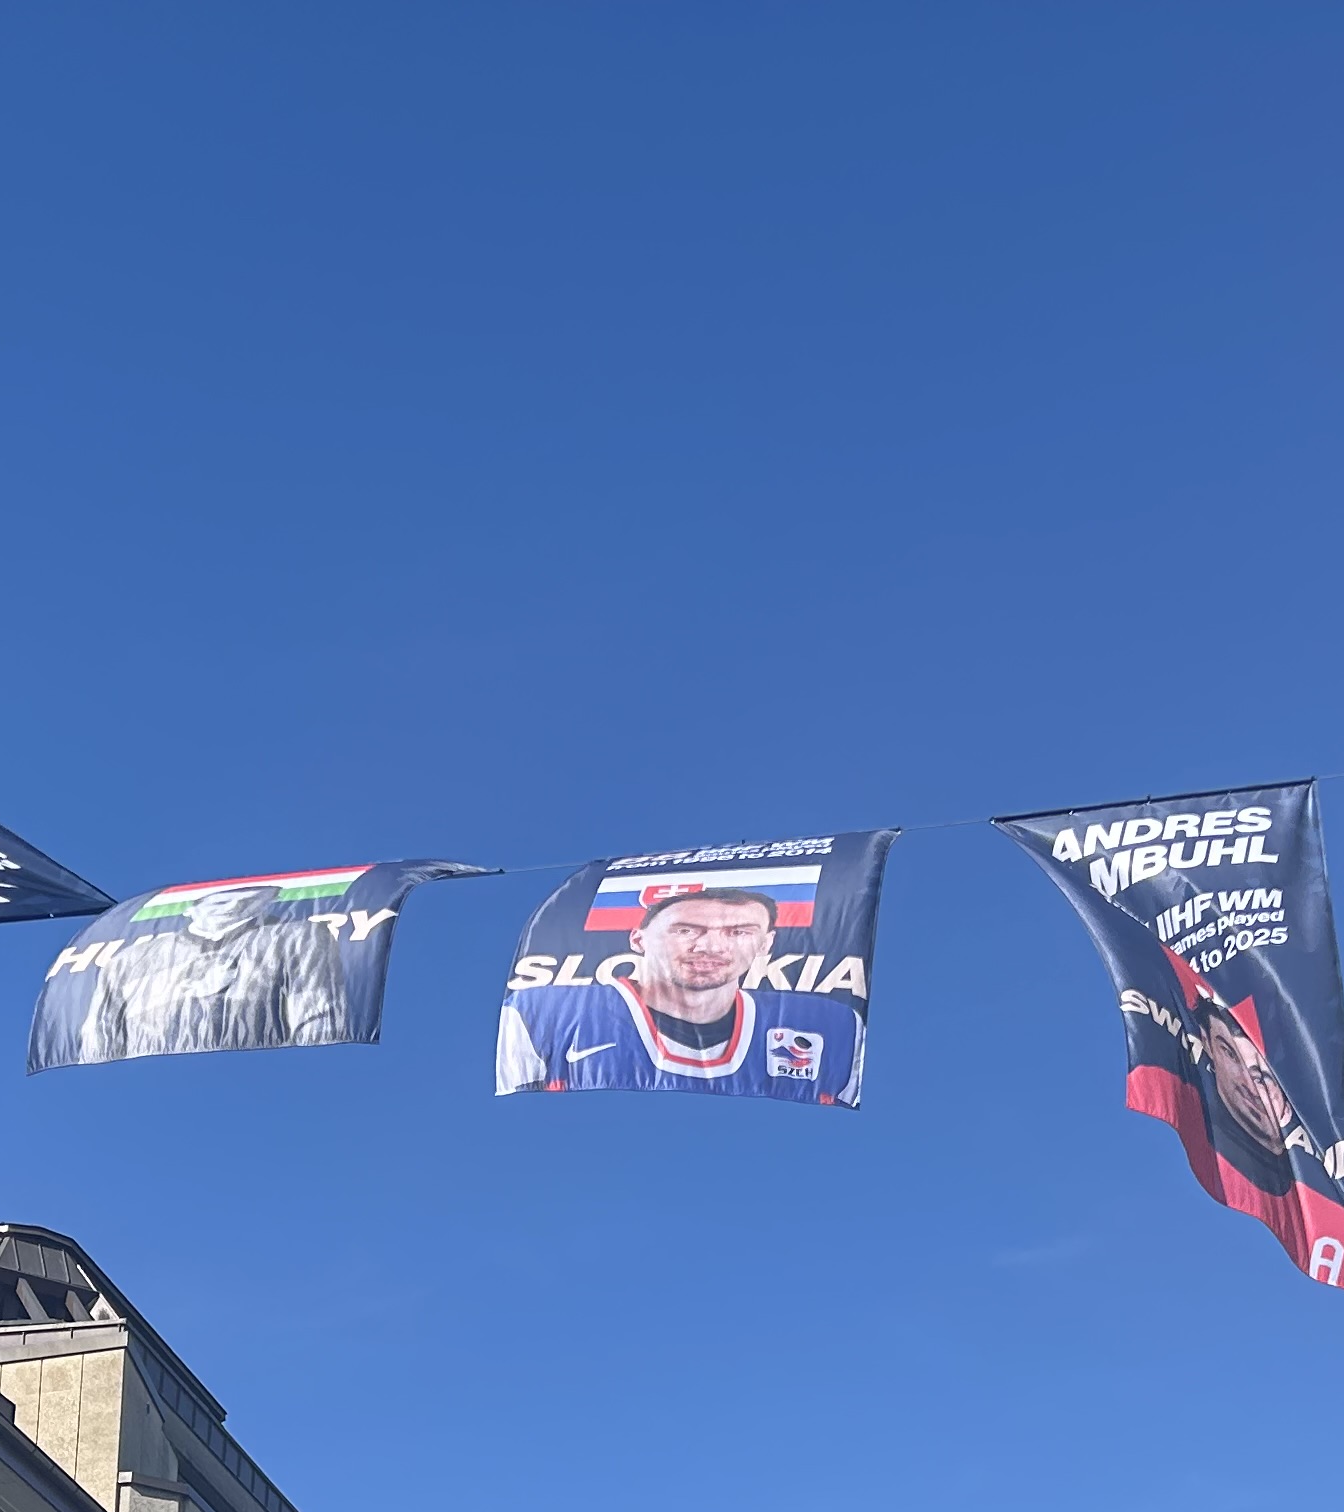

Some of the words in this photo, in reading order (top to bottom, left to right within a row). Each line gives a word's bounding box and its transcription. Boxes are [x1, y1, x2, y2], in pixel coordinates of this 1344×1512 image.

[1052, 807, 1272, 863] ANDRES
[1089, 835, 1279, 897] MBUHL
[1156, 892, 1214, 942] IIHF
[1218, 888, 1284, 912] WM
[1218, 909, 1285, 936] played
[1200, 948, 1223, 973] to
[1223, 926, 1289, 961] 2025
[506, 952, 868, 1000] SLOKIA
